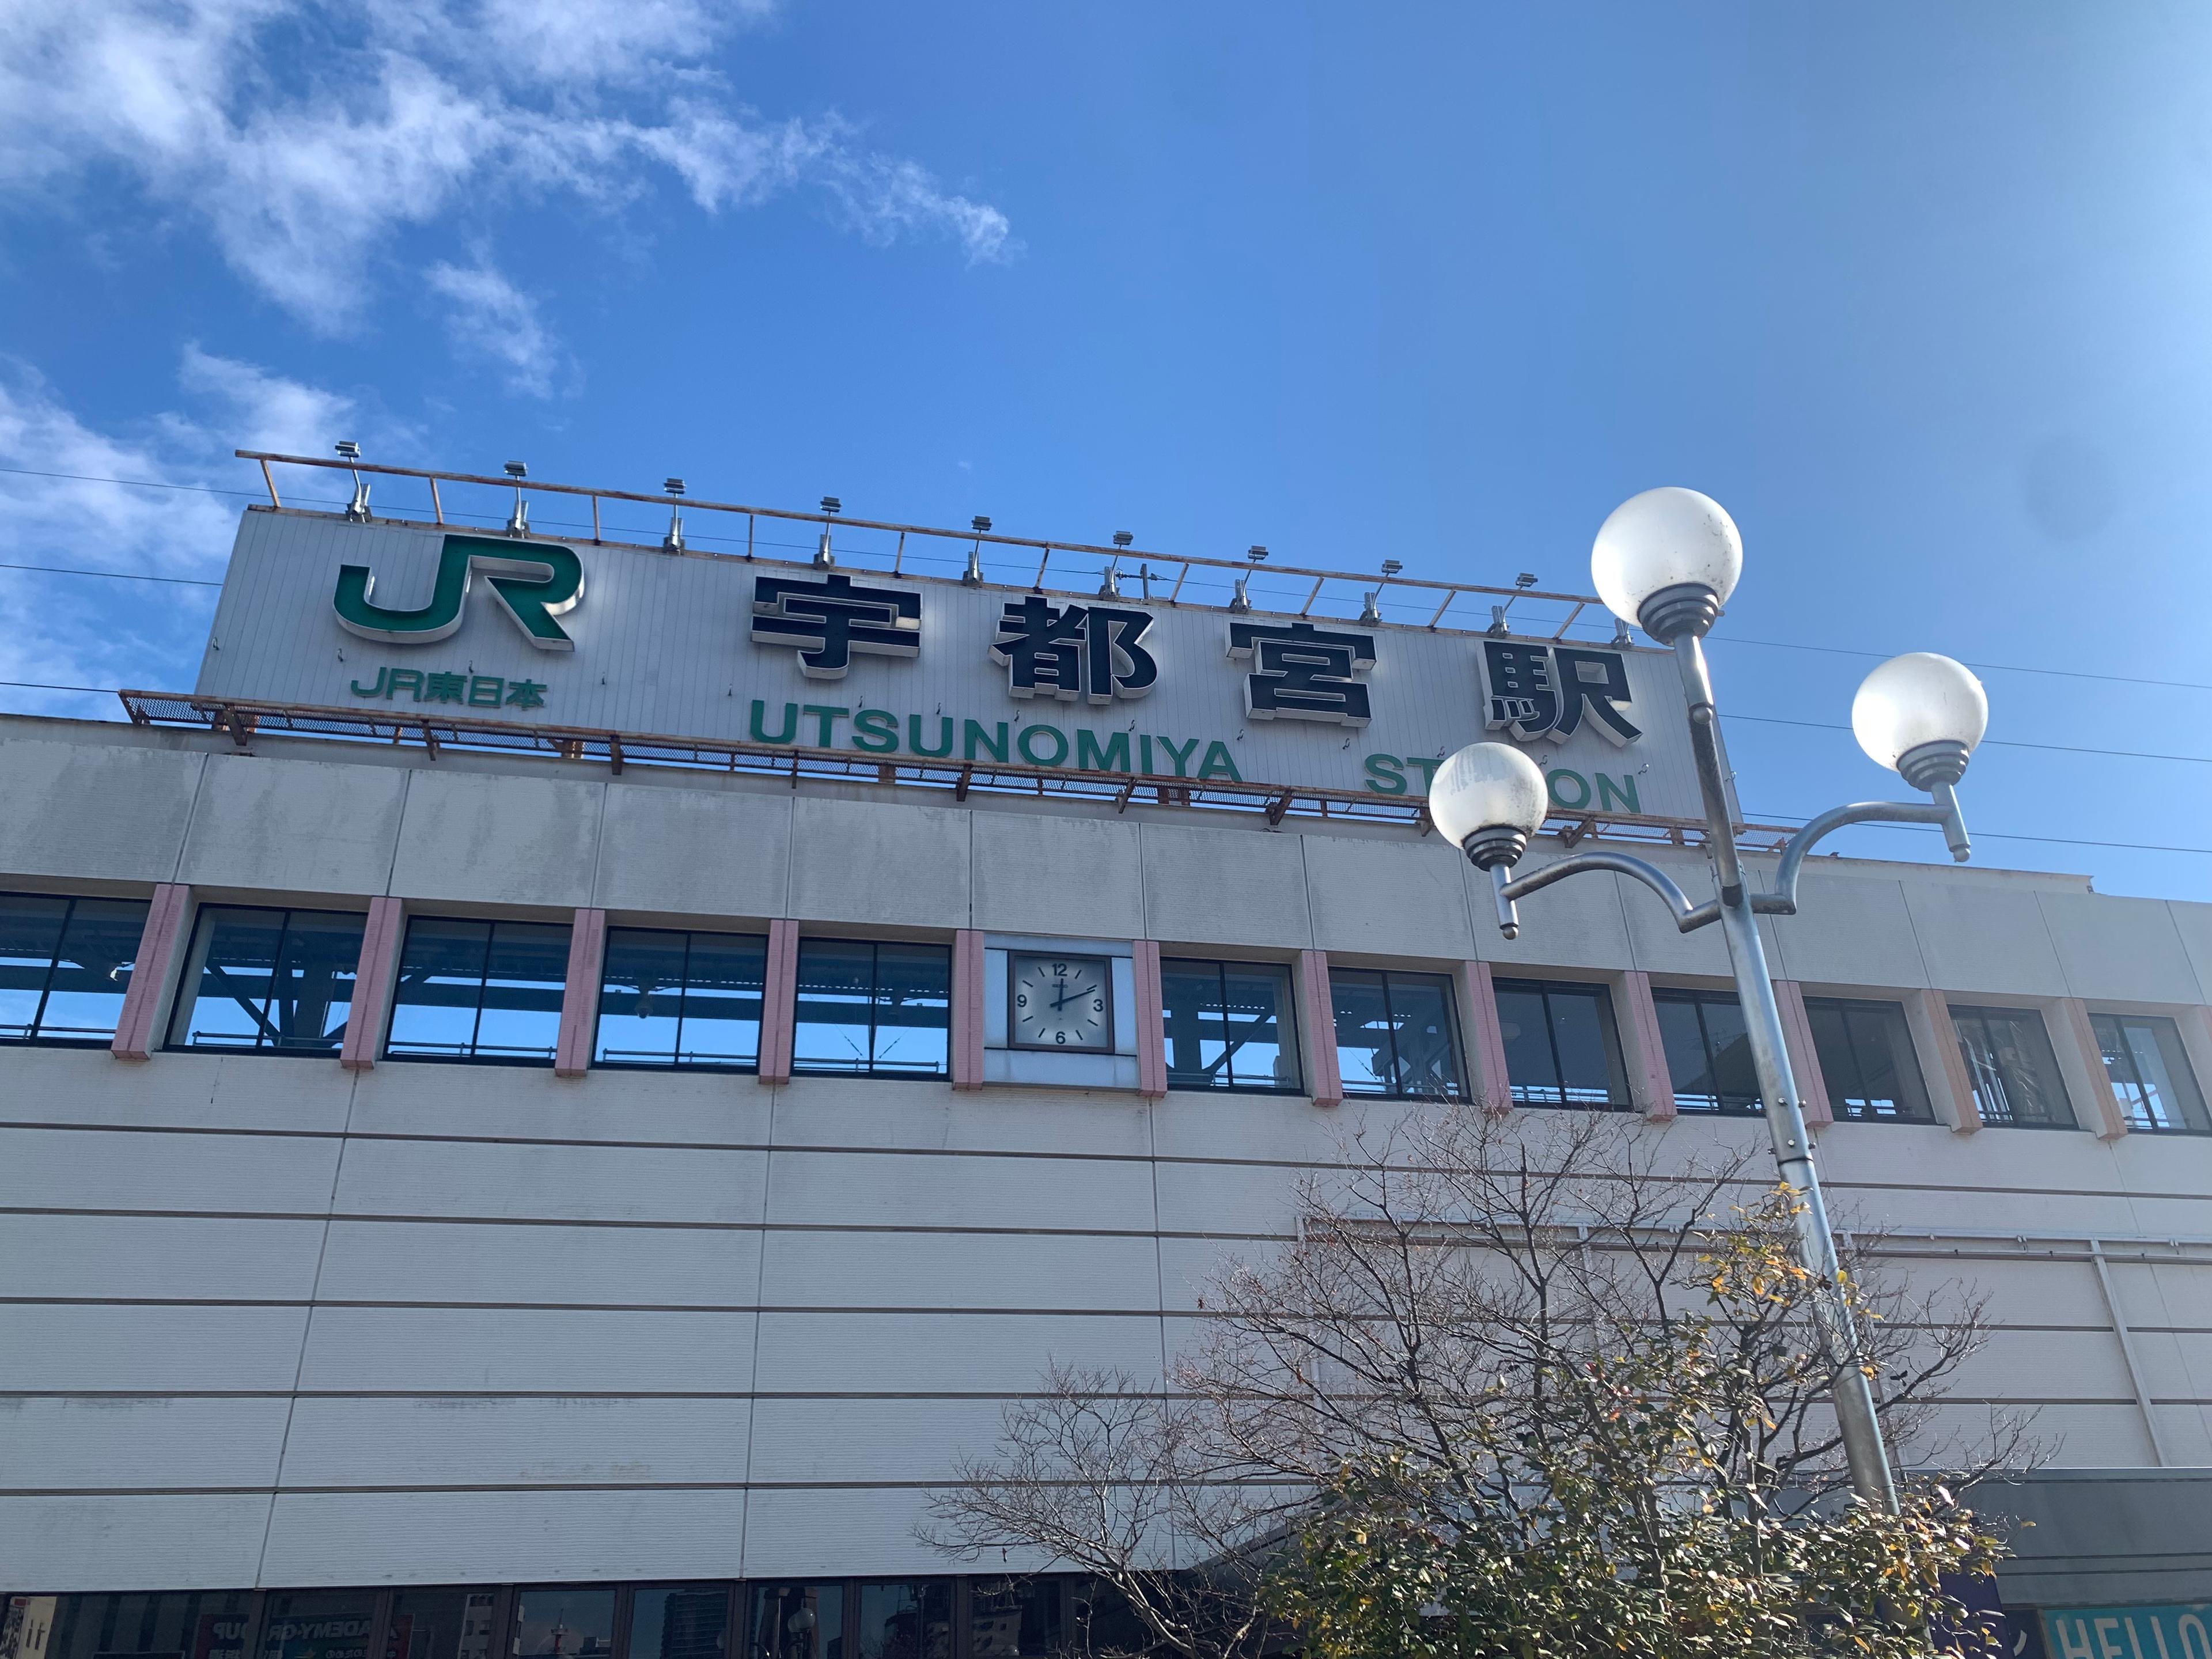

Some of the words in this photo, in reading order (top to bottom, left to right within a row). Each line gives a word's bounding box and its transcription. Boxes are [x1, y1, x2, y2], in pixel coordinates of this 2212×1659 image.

[334, 534, 585, 652] JR
[751, 574, 1643, 748] 宇都宮駅
[351, 666, 548, 709] JR東日本
[750, 699, 1243, 782] UTSUNOMIYA
[1365, 753, 1642, 813] STON
[1052, 963, 1067, 976] 12
[1017, 994, 1027, 1007] 9
[1093, 999, 1103, 1012] 3
[1055, 1031, 1066, 1044] 6
